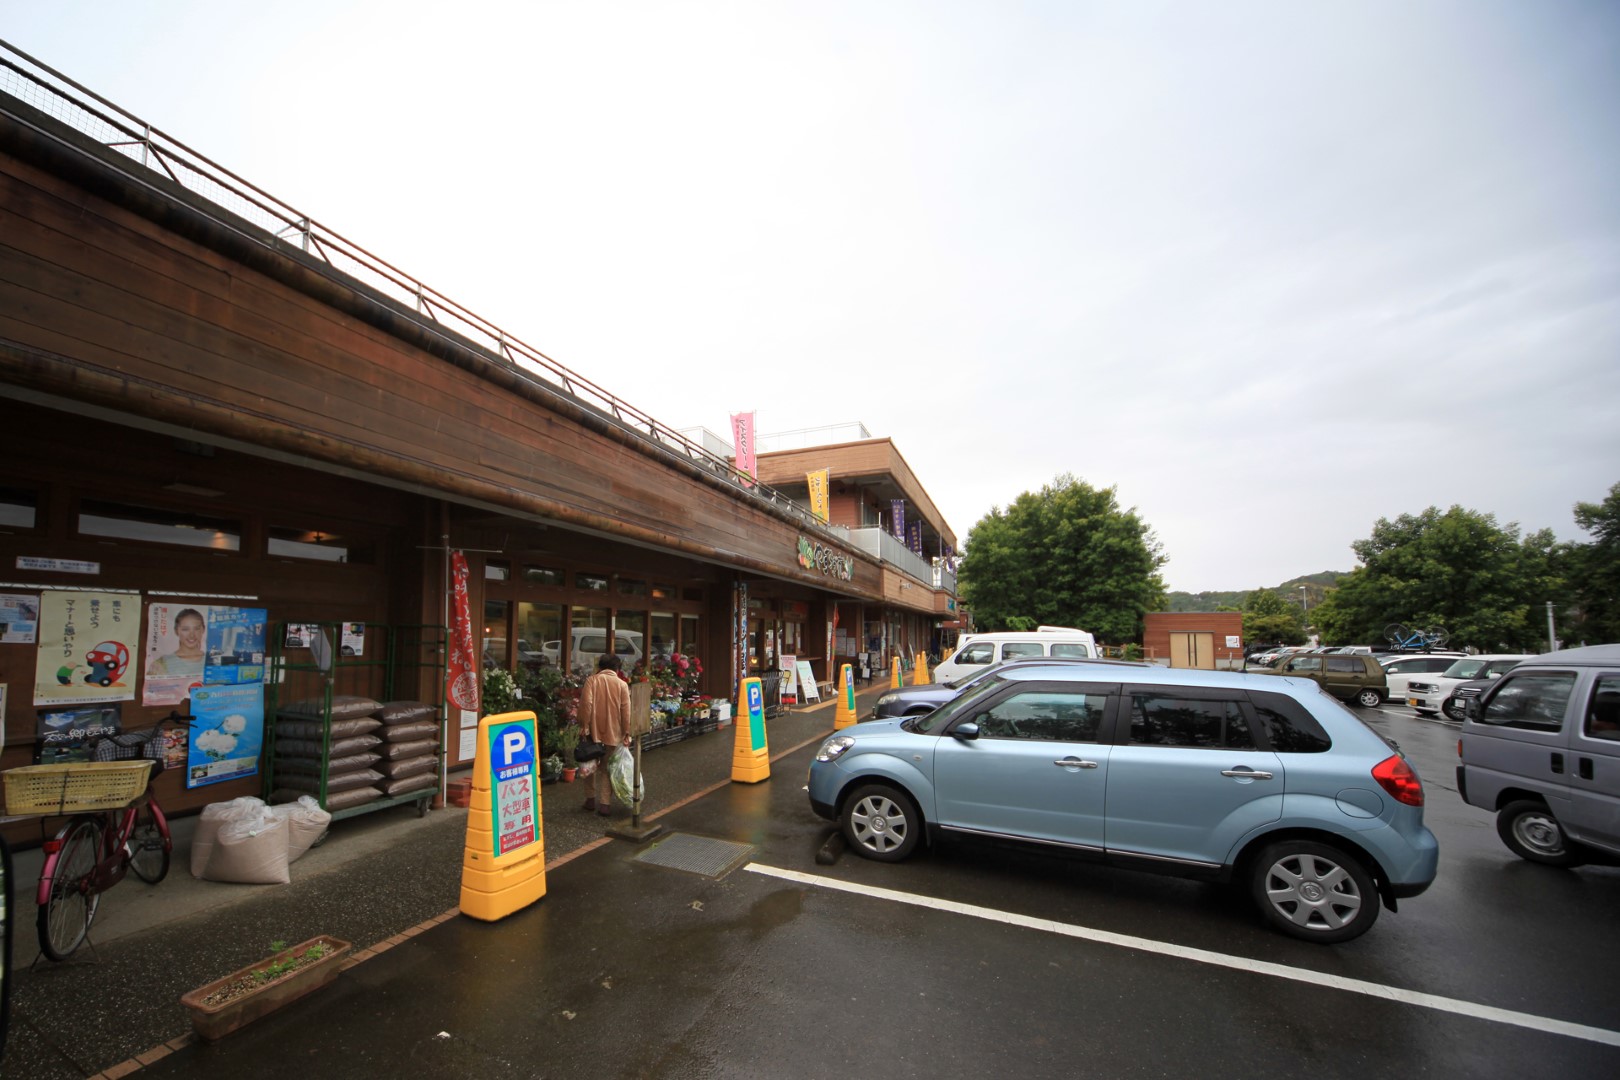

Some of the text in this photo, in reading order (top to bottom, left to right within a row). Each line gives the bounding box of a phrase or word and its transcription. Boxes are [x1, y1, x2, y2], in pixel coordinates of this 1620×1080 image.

[63, 599, 75, 658] マナーと思いやり
[751, 687, 759, 705] P
[503, 731, 526, 766] P
[502, 778, 530, 799] バス
[502, 797, 531, 818] 大型車
